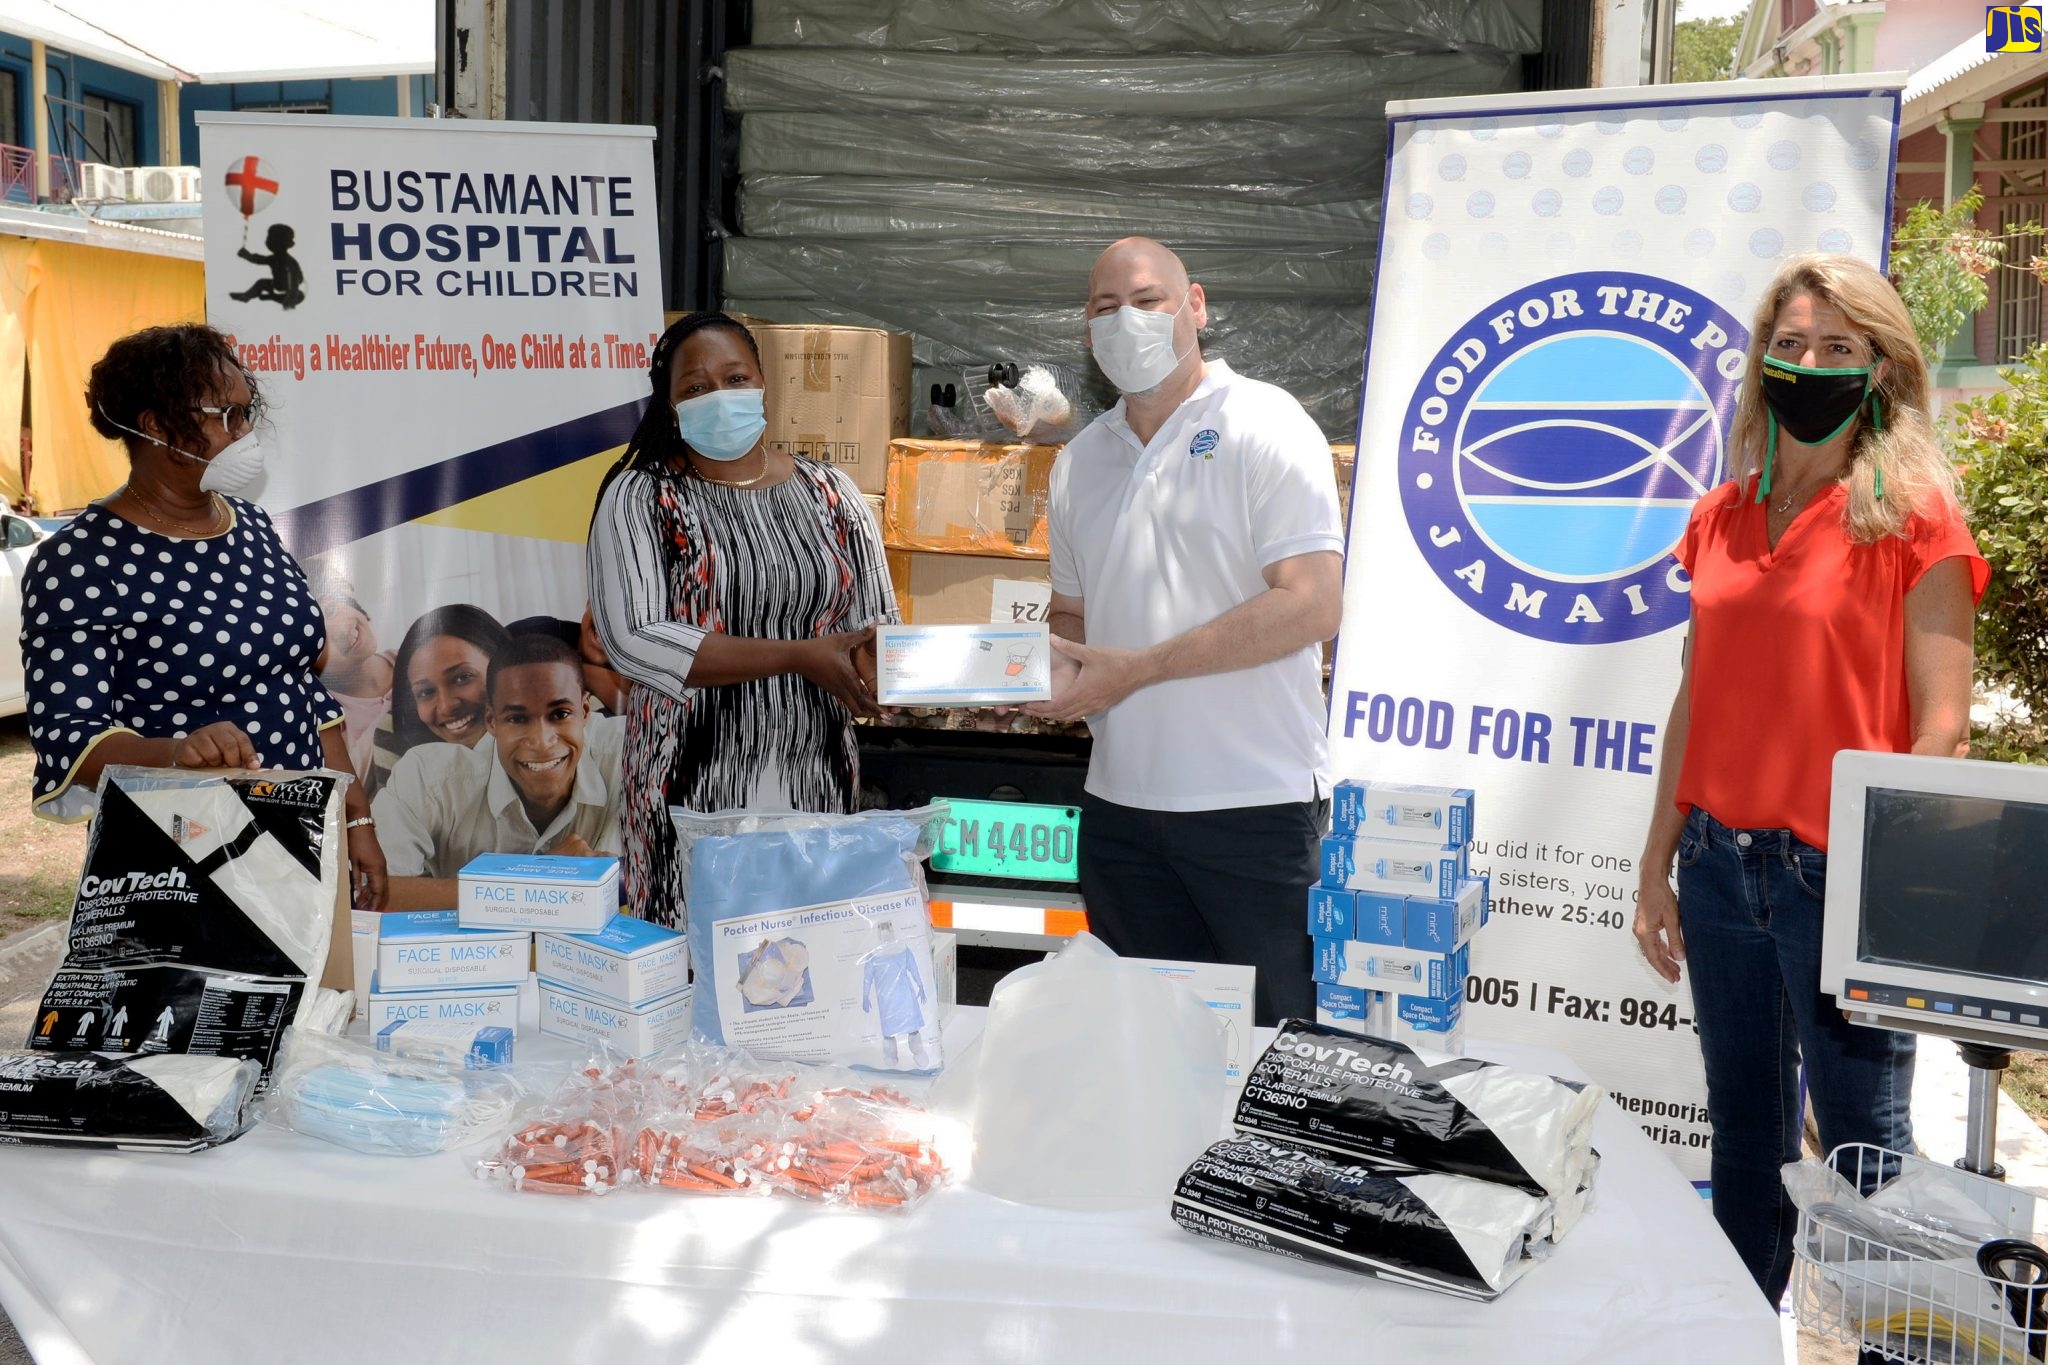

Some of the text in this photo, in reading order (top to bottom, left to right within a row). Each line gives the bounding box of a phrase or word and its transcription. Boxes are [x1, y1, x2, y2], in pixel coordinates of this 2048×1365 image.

[330, 169, 635, 217] BUSTAMANTE
[331, 222, 636, 265] HOSPITAL
[336, 269, 639, 298] FOR CHILDREN
[310, 343, 322, 371] a
[326, 334, 411, 371] Healthier
[414, 333, 478, 379] Future,
[481, 333, 517, 370] One
[521, 333, 565, 370] Child
[569, 334, 587, 369] at
[590, 342, 602, 369] a
[1412, 285, 1749, 454] FOOD FOR THE PO
[1002, 468, 1022, 480] KGS
[1002, 485, 1021, 496] KGS
[1000, 500, 1021, 513] PCS
[1429, 525, 1692, 624] JAMAIC
[1344, 690, 1657, 776] FOOD FOR THE
[271, 791, 323, 804] SAFETY
[1348, 792, 1356, 831] Space Chamber
[939, 817, 1074, 864] CM 4480
[1337, 845, 1345, 868] Chamber
[1496, 840, 1529, 860] did
[1535, 842, 1548, 862] it
[1555, 845, 1585, 866] for
[1591, 854, 1632, 873] one
[81, 866, 188, 898] CovTech
[1499, 871, 1576, 897] sisters,
[1584, 881, 1624, 903] you
[79, 890, 199, 911] DISPOSABLE PROTECTIVE
[475, 886, 569, 905] FACE MASK
[76, 905, 126, 923] COVERALLS
[407, 912, 441, 920] FACE
[485, 905, 560, 916] SURGICAL DISPOSABLE
[723, 924, 759, 937] Pocket
[799, 909, 854, 925] Infectious
[857, 902, 902, 916] Disease
[904, 896, 917, 908] Kit
[1325, 895, 1333, 933] Space Chamber
[1488, 898, 1625, 930] athew 25:40
[104, 920, 135, 933] PREMIUM
[71, 933, 113, 949] CT365NO
[398, 945, 497, 963] FACE MASK
[544, 940, 609, 972] FACE MASK
[408, 965, 488, 975] SURGICAL DISPOSABLE
[552, 961, 575, 974] SURGICAL
[1329, 963, 1337, 981] Space
[52, 982, 100, 990] BREATHABLE
[54, 990, 75, 998] SOFT
[1329, 992, 1352, 1002] Compact
[386, 1002, 486, 1020] FACE MASK
[549, 996, 617, 1028] FACE MASK
[1322, 1000, 1361, 1011] Space Chamber
[1402, 1010, 1418, 1020] Space
[1418, 1012, 1441, 1023] Chamber
[1410, 1003, 1433, 1014] Compact
[1548, 985, 1611, 1023] Fax:
[1273, 1032, 1413, 1084] CovTech
[0, 1082, 34, 1093] REMIUM
[1258, 1062, 1333, 1088] COVERALLS
[1264, 1052, 1424, 1099] DISPOSABLE PROTECTIVE
[1245, 1085, 1308, 1110] CT365NO
[1250, 1076, 1342, 1104] 2X-LARGE PREMIUM
[1192, 1161, 1256, 1187] CT365NO
[1200, 1154, 1256, 1175] 2X-GRANDE
[1208, 1146, 1304, 1177] DESECHABLE
[1217, 1142, 1271, 1160] OVEROL
[1276, 1158, 1364, 1185] PROTECTOR
[1176, 1206, 1205, 1224] EXTRA
[1234, 1234, 1256, 1248] ANTI
[1256, 1240, 1304, 1260] ESTATICO
